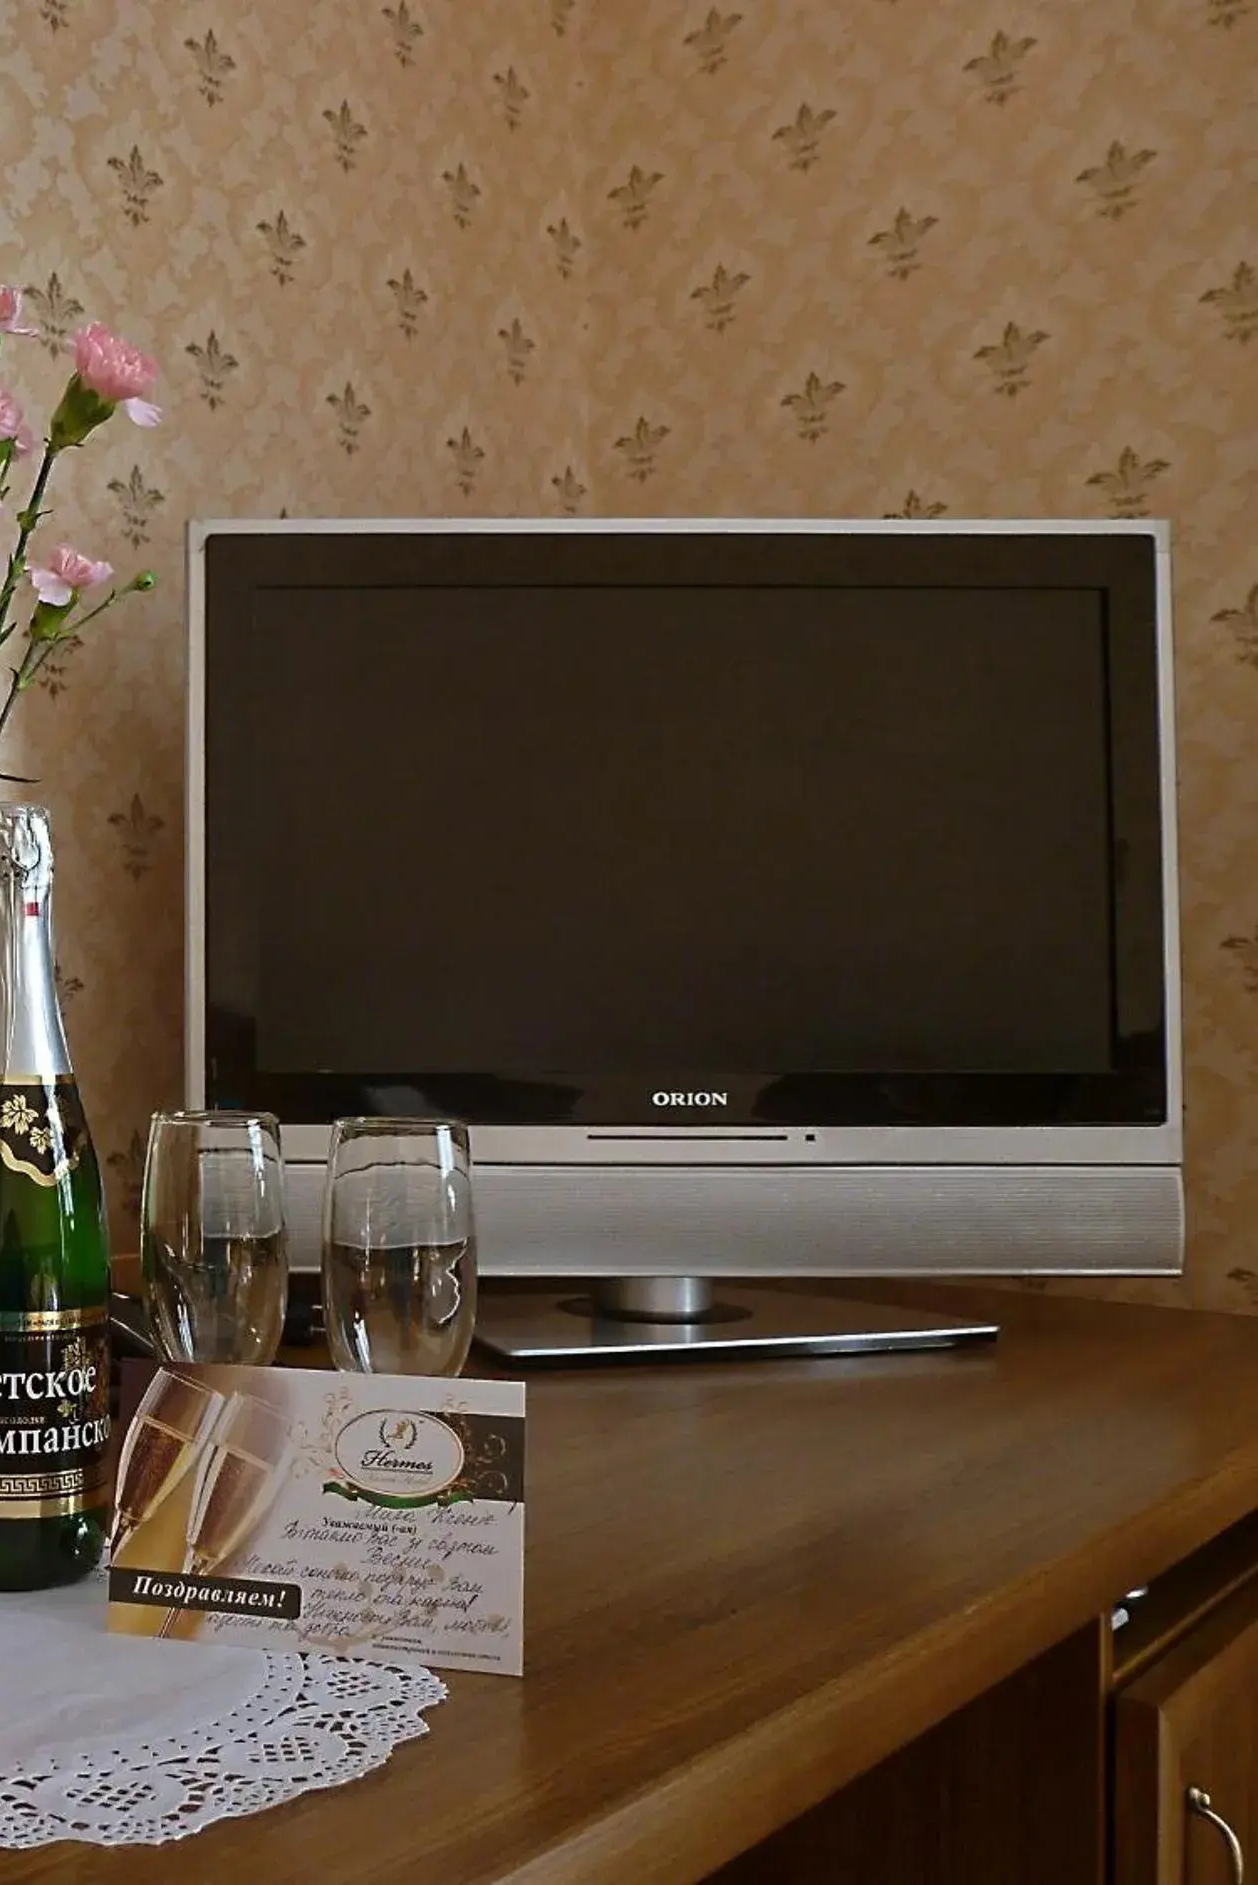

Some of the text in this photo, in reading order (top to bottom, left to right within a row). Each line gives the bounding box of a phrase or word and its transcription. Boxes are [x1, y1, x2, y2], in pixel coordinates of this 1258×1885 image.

[652, 1091, 727, 1106] ORION
[361, 1450, 434, 1470] Hermes
[133, 1575, 286, 1608] Поздравляем!
